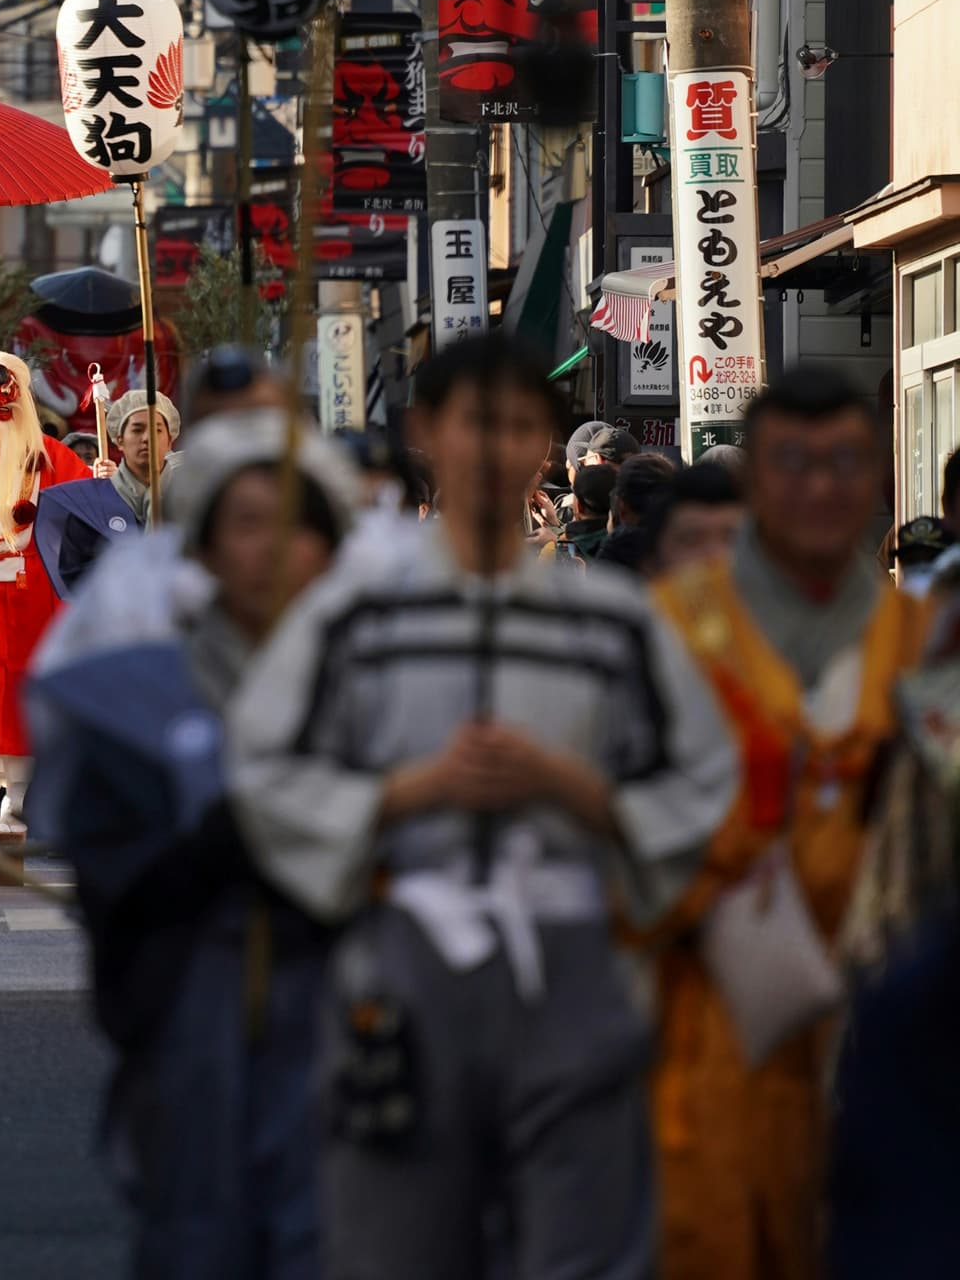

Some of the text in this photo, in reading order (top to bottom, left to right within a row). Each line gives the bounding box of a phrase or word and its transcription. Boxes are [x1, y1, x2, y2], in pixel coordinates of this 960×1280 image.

[686, 80, 739, 141] 質
[689, 152, 740, 179] 買取
[363, 199, 425, 212] 下北沢一番街
[444, 229, 476, 305] 玉屋
[695, 189, 744, 351] ともえや
[714, 355, 756, 369] この手前
[715, 370, 757, 384] 北沢2-32-8
[690, 386, 758, 401] 3468-0156
